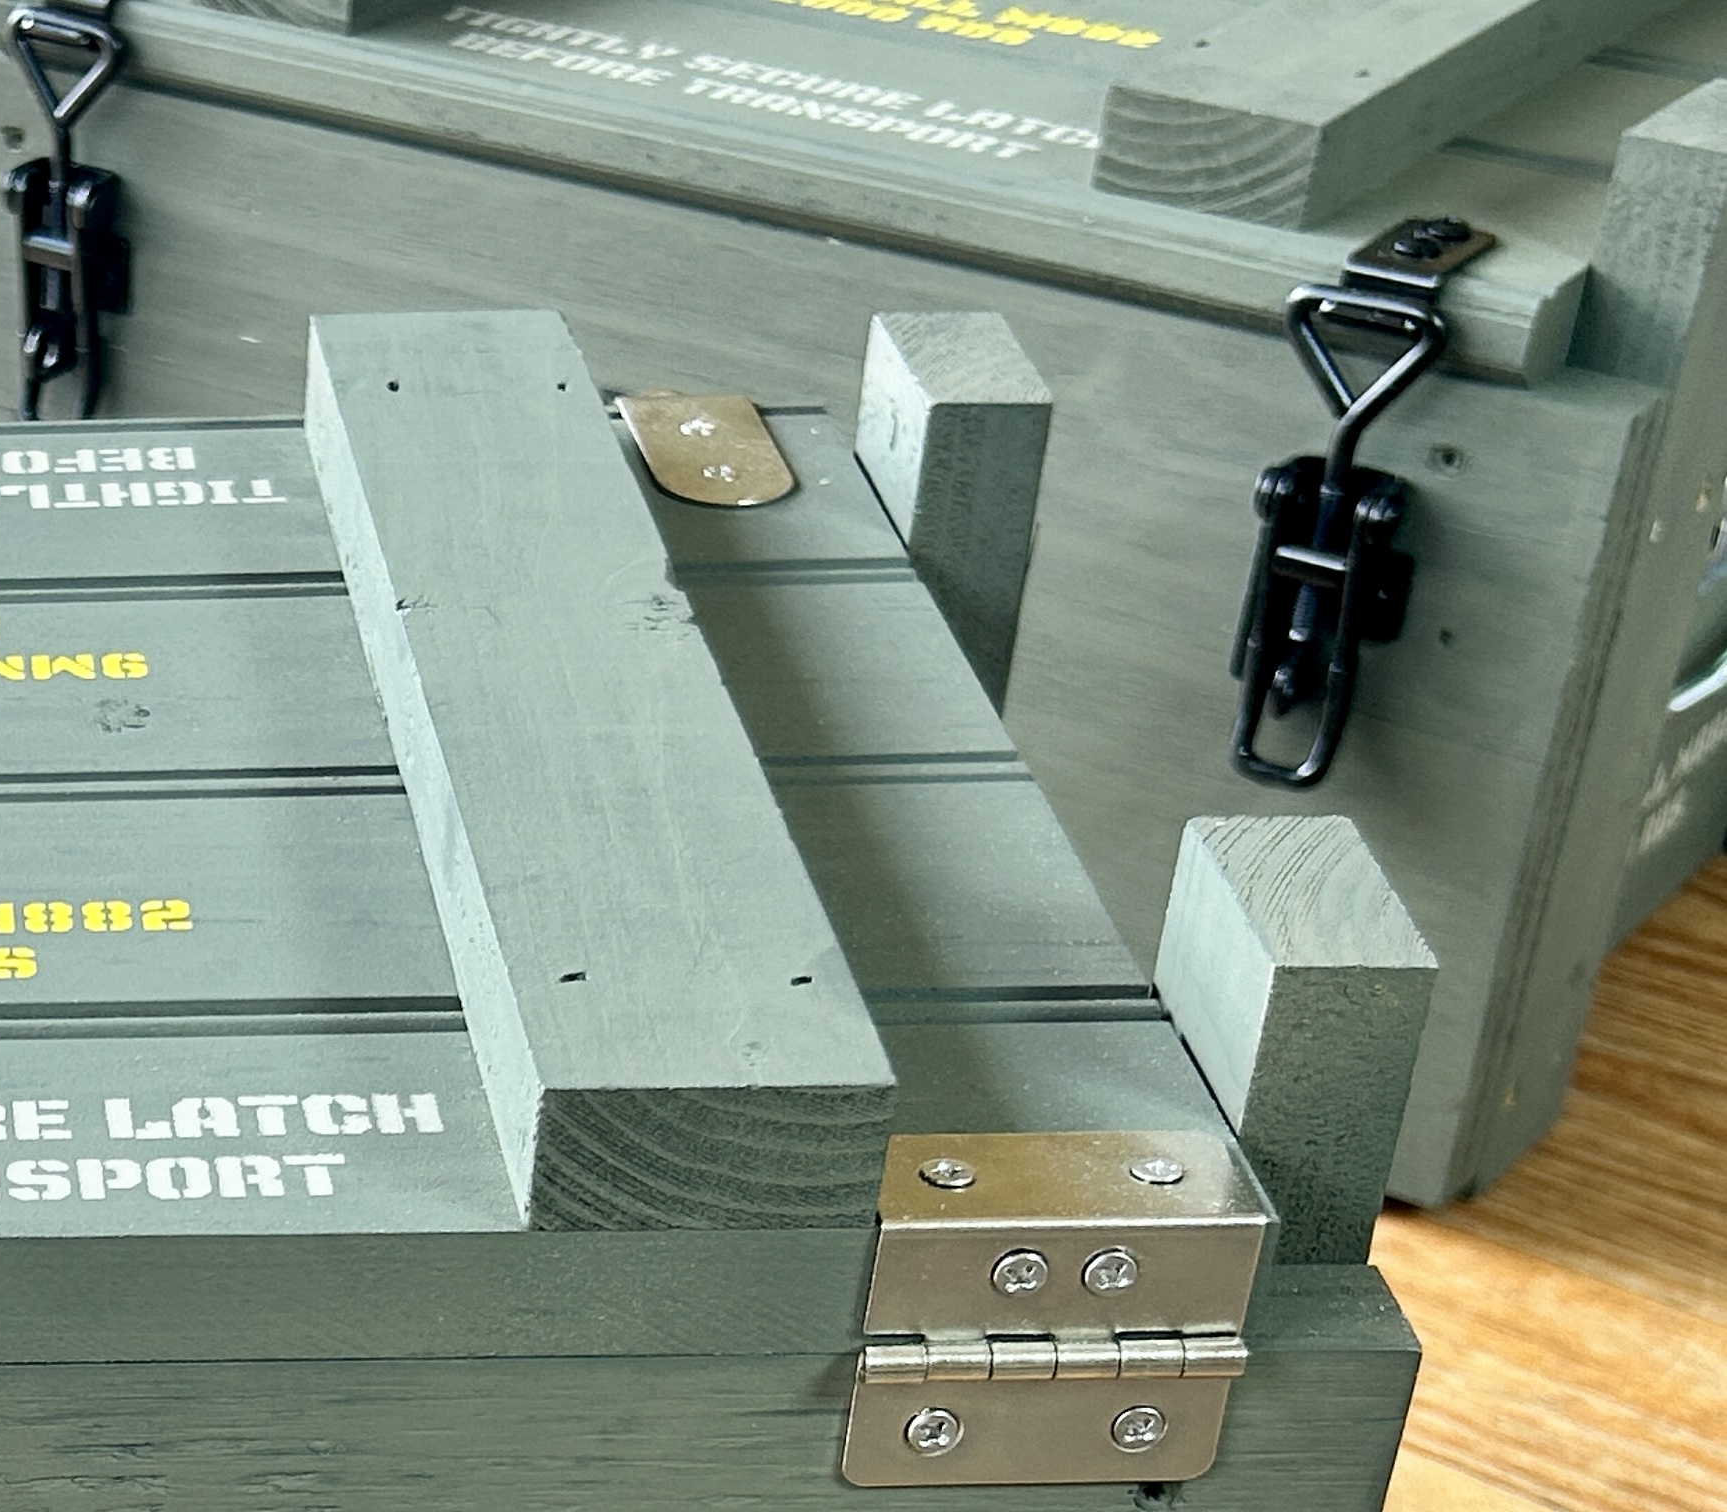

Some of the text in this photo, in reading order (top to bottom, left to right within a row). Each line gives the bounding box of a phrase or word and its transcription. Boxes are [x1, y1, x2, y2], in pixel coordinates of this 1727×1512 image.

[917, 13, 1035, 46] RDS
[995, 6, 1162, 49] M882
[445, 6, 682, 60] TIGHTLY
[684, 55, 923, 109] SECURE
[450, 33, 1043, 159] BEFORE TRANSPORT
[104, 1092, 445, 1141] LATCH
